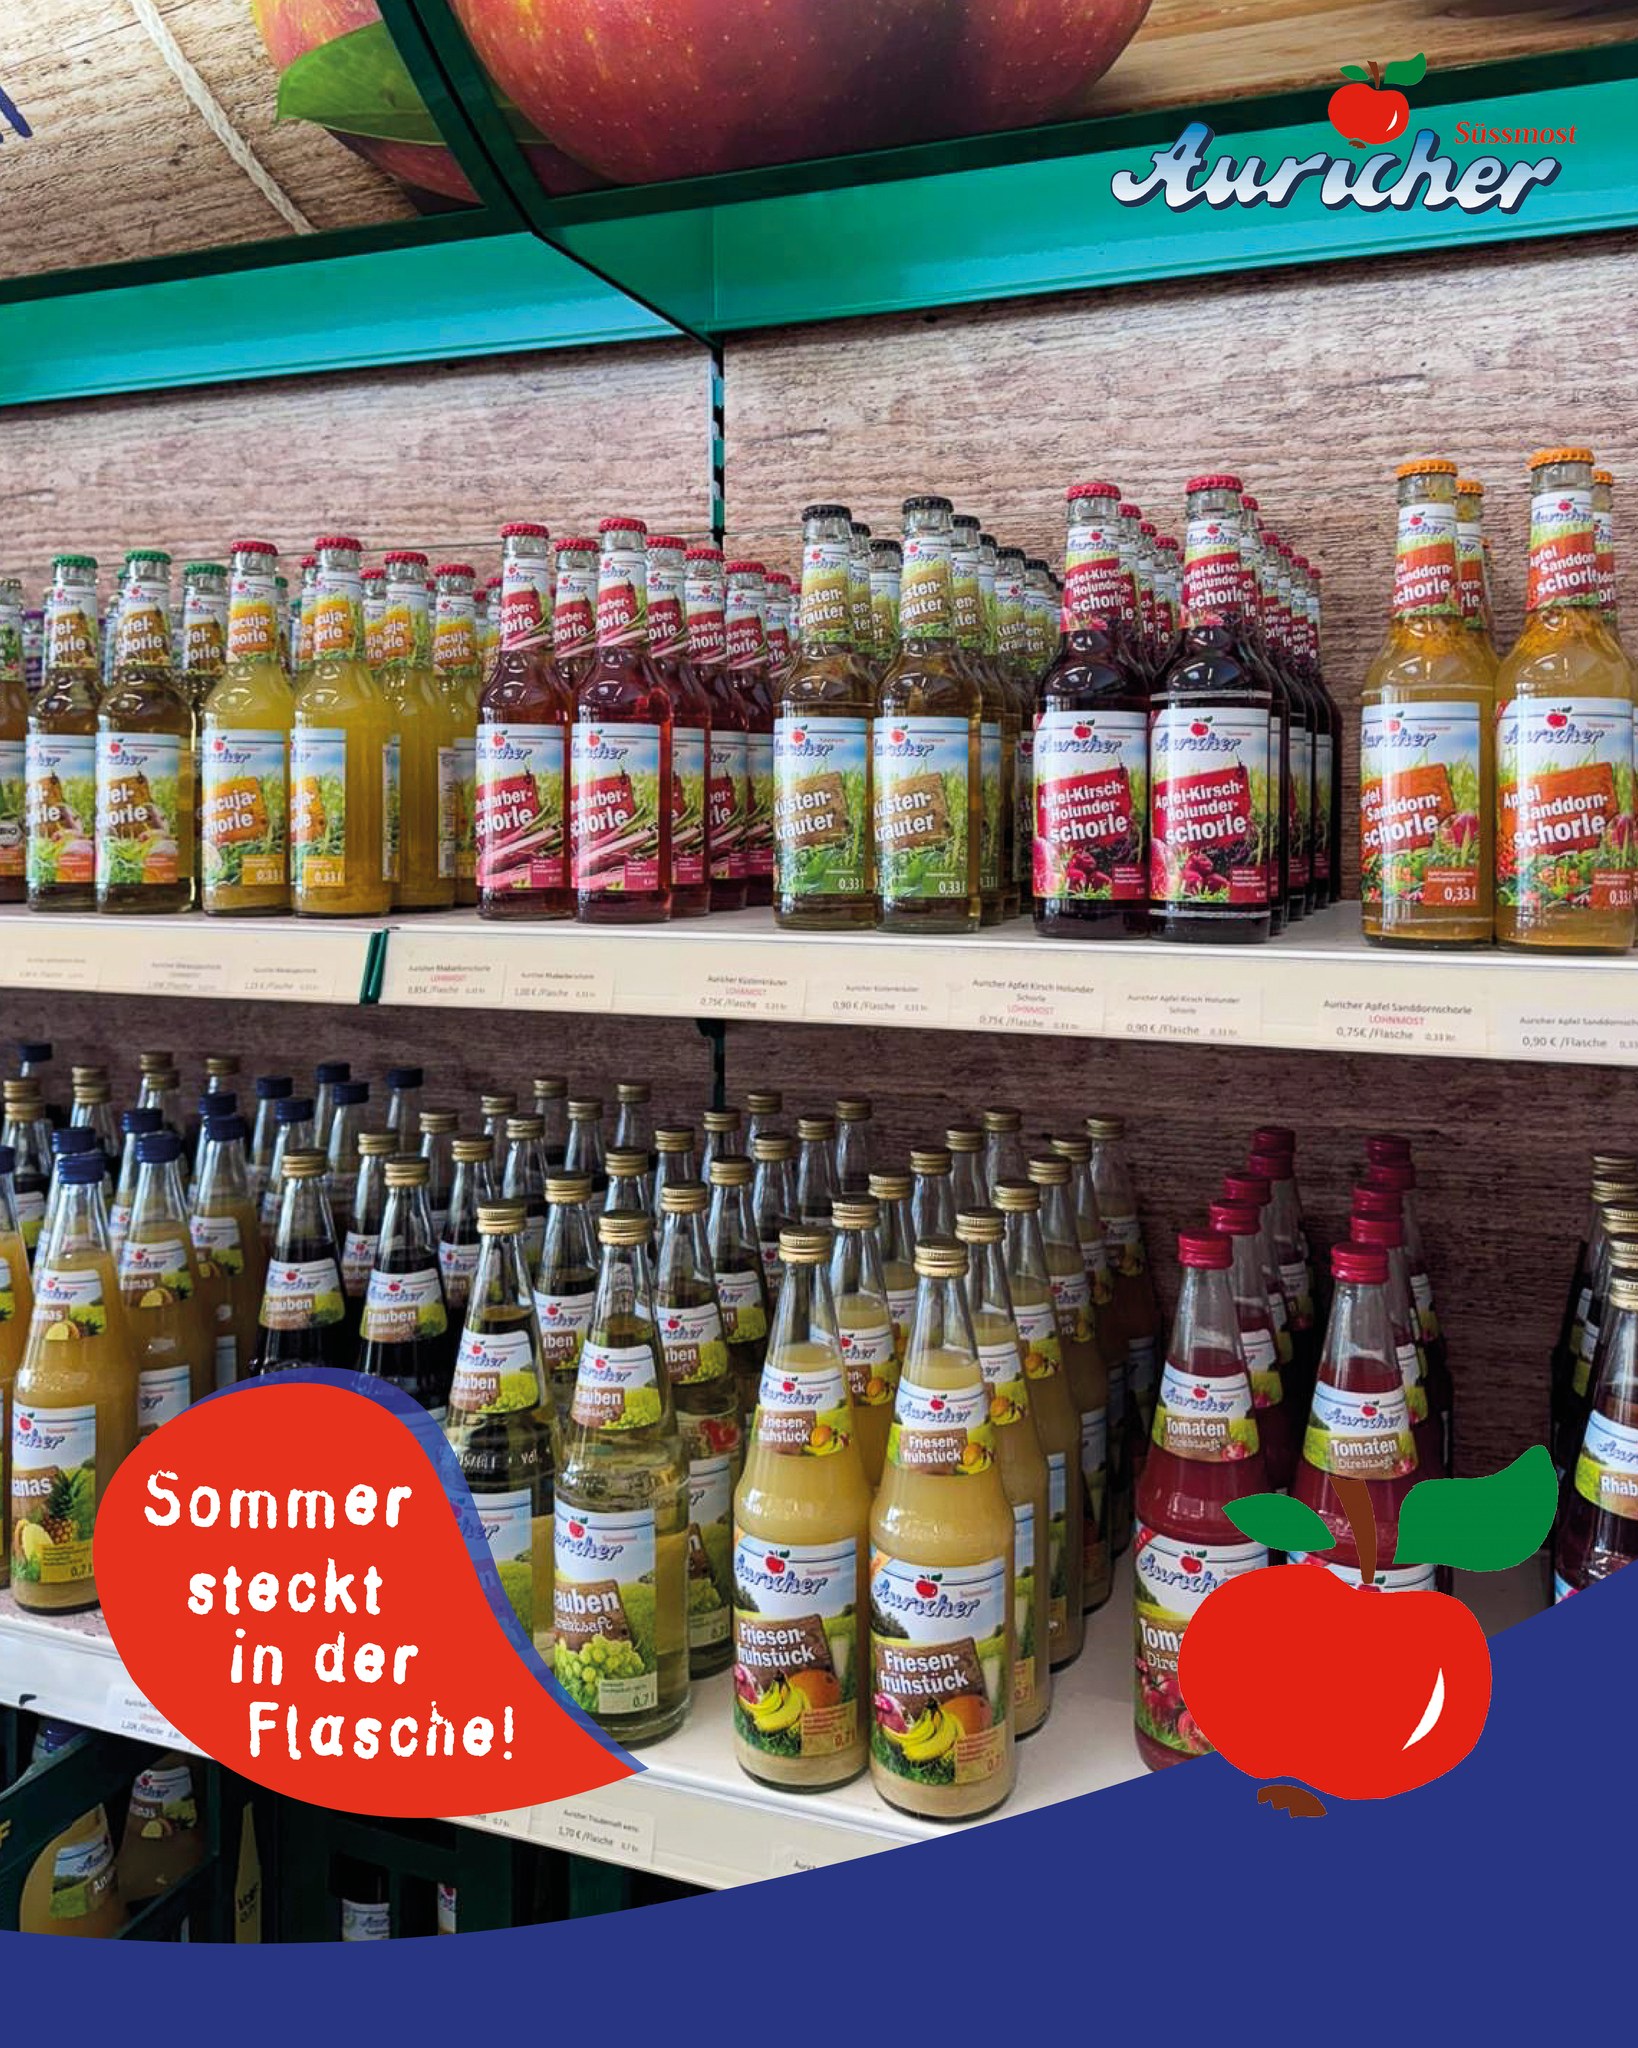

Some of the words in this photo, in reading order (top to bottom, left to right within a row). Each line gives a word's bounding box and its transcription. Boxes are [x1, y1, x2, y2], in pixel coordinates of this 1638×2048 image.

[1366, 791, 1442, 824] Sanddorn-
[1518, 790, 1609, 823] Sanddorn-
[1049, 814, 1128, 844] schorle
[1164, 813, 1247, 845] schorle
[1363, 813, 1440, 849] schorle
[1512, 814, 1607, 850] schorle
[1165, 1416, 1226, 1437] Tomaten
[1330, 1436, 1398, 1458] Tomaten
[738, 1622, 807, 1648] Friesen-
[884, 1648, 961, 1674] Friesen-
[880, 1669, 970, 1697] frühstück
